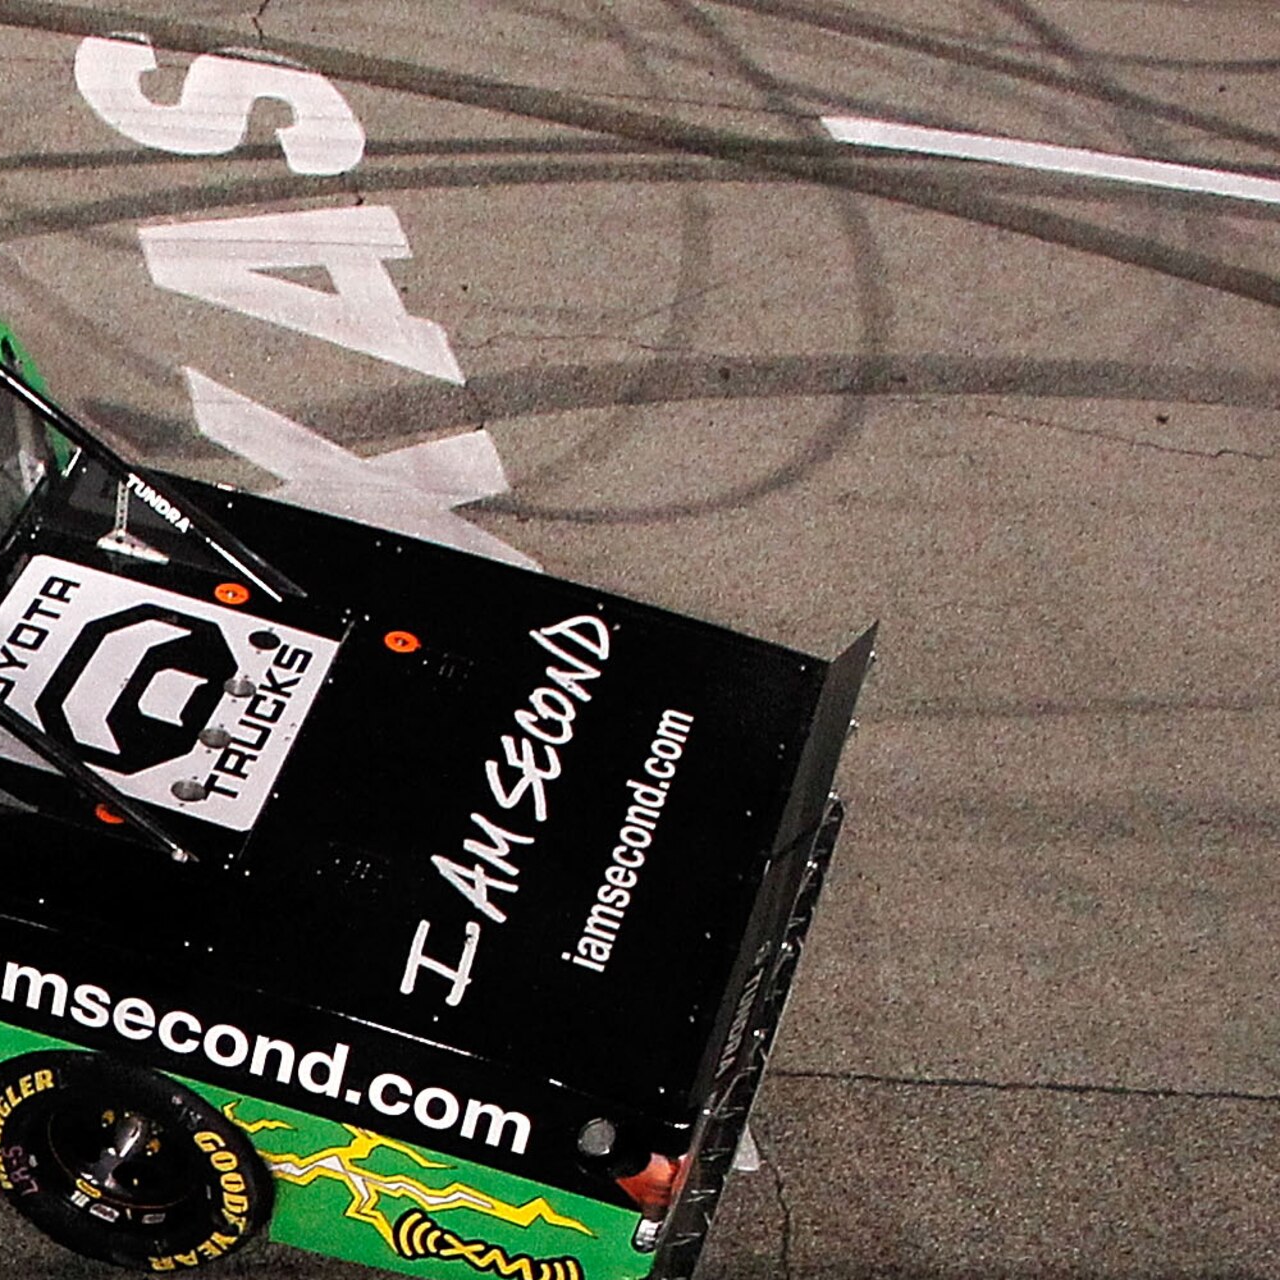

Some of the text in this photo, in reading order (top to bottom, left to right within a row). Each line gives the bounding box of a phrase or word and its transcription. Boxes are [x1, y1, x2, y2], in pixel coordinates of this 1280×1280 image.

[125, 475, 192, 533] TUNDRA
[205, 643, 314, 799] TRUCKS
[398, 614, 611, 1008] I AM SECOND
[560, 708, 695, 973] iamsecond.com
[147, 1130, 250, 1272] GOODYEAR
